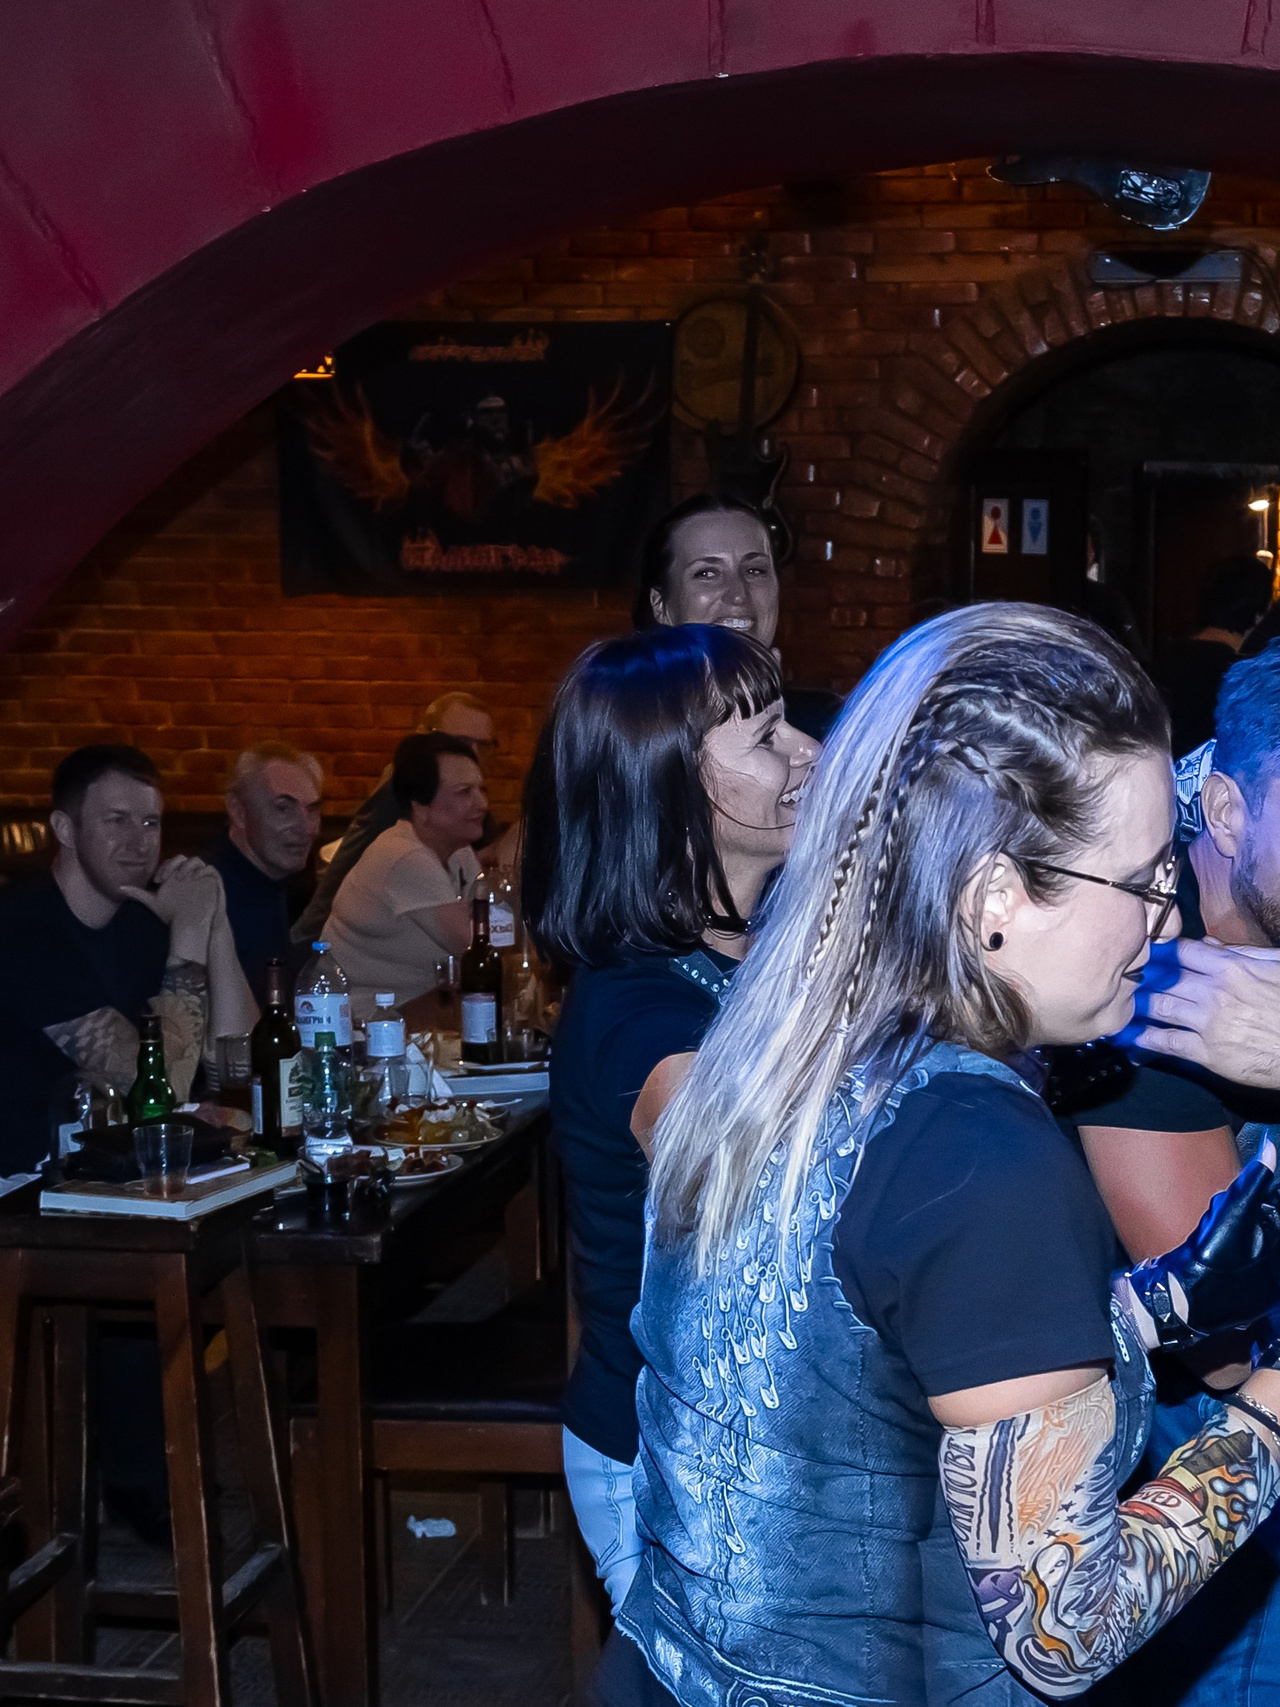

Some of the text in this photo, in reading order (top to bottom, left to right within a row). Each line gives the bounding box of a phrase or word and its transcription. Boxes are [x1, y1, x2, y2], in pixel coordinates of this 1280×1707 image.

[944, 1437, 976, 1471] BE
[943, 1468, 977, 1498] TO
[1136, 1491, 1181, 1508] VED
